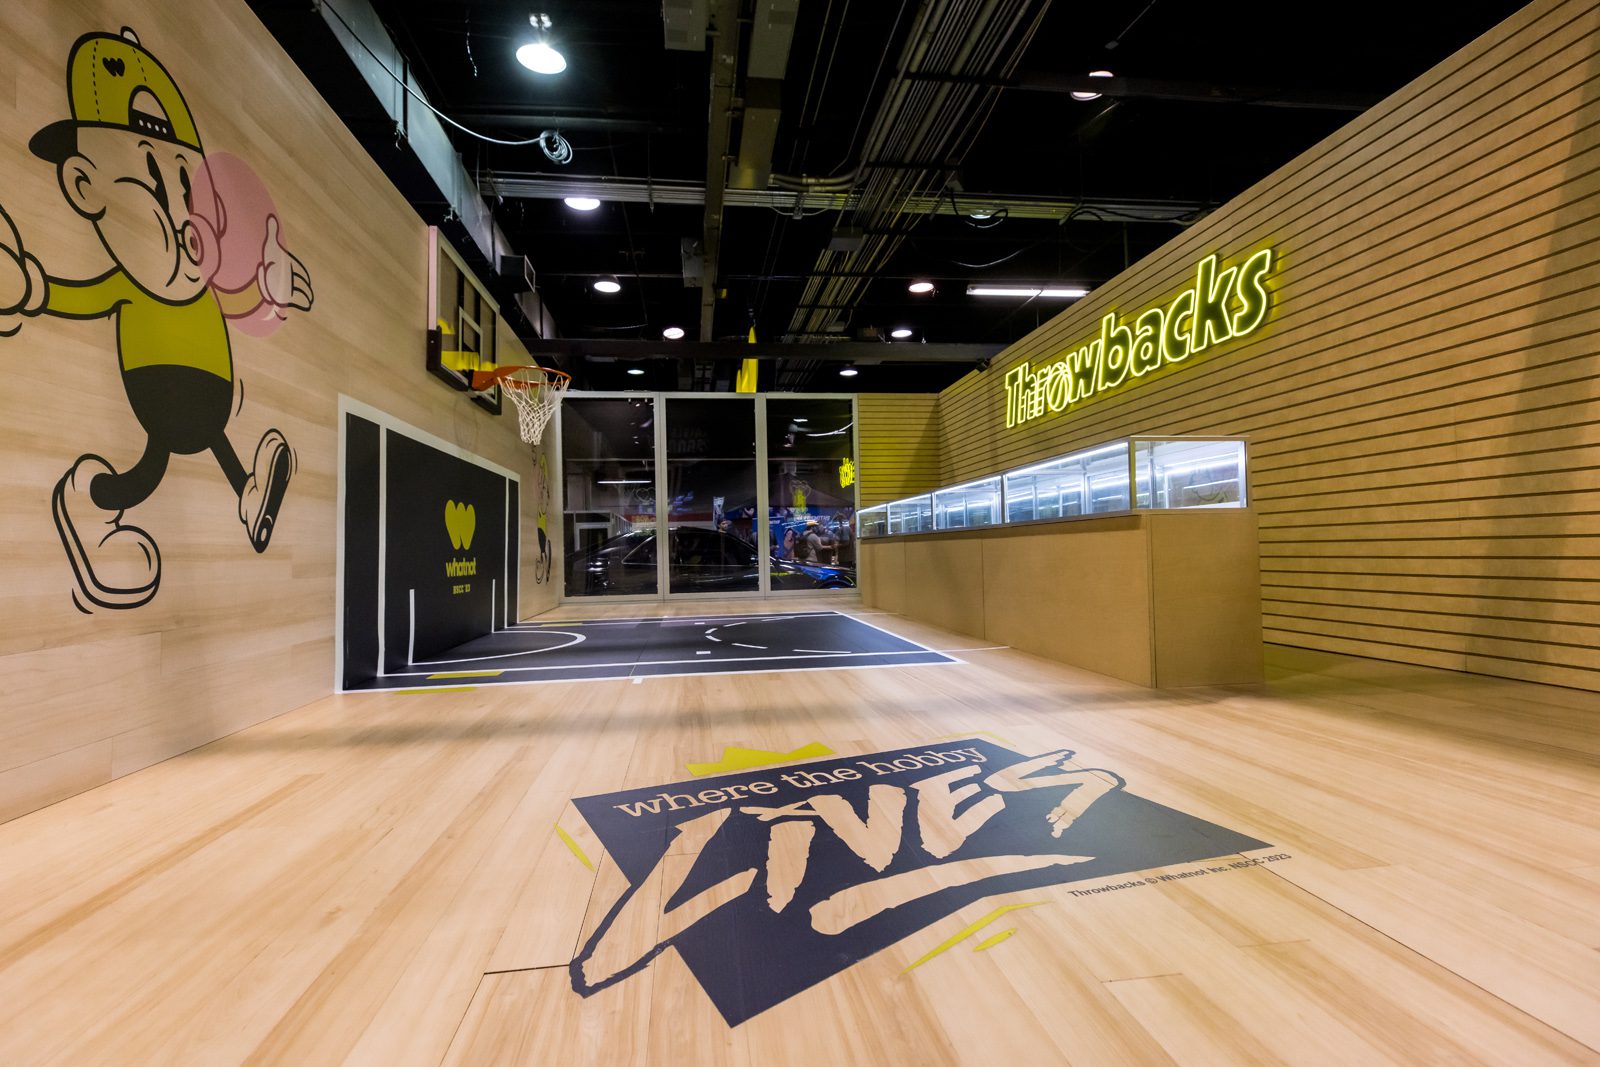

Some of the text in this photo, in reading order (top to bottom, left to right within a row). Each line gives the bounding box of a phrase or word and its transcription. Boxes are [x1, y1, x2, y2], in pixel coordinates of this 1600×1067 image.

[1004, 249, 1271, 428] Throwbacks
[446, 557, 476, 577] whatnot
[613, 746, 987, 818] where the hobby
[580, 750, 1122, 988] LIVES
[1067, 880, 1146, 897] Throwbacks
[1156, 867, 1209, 882] Whatnot
[1207, 864, 1231, 874] Inc.
[1228, 858, 1264, 870] NSCC
